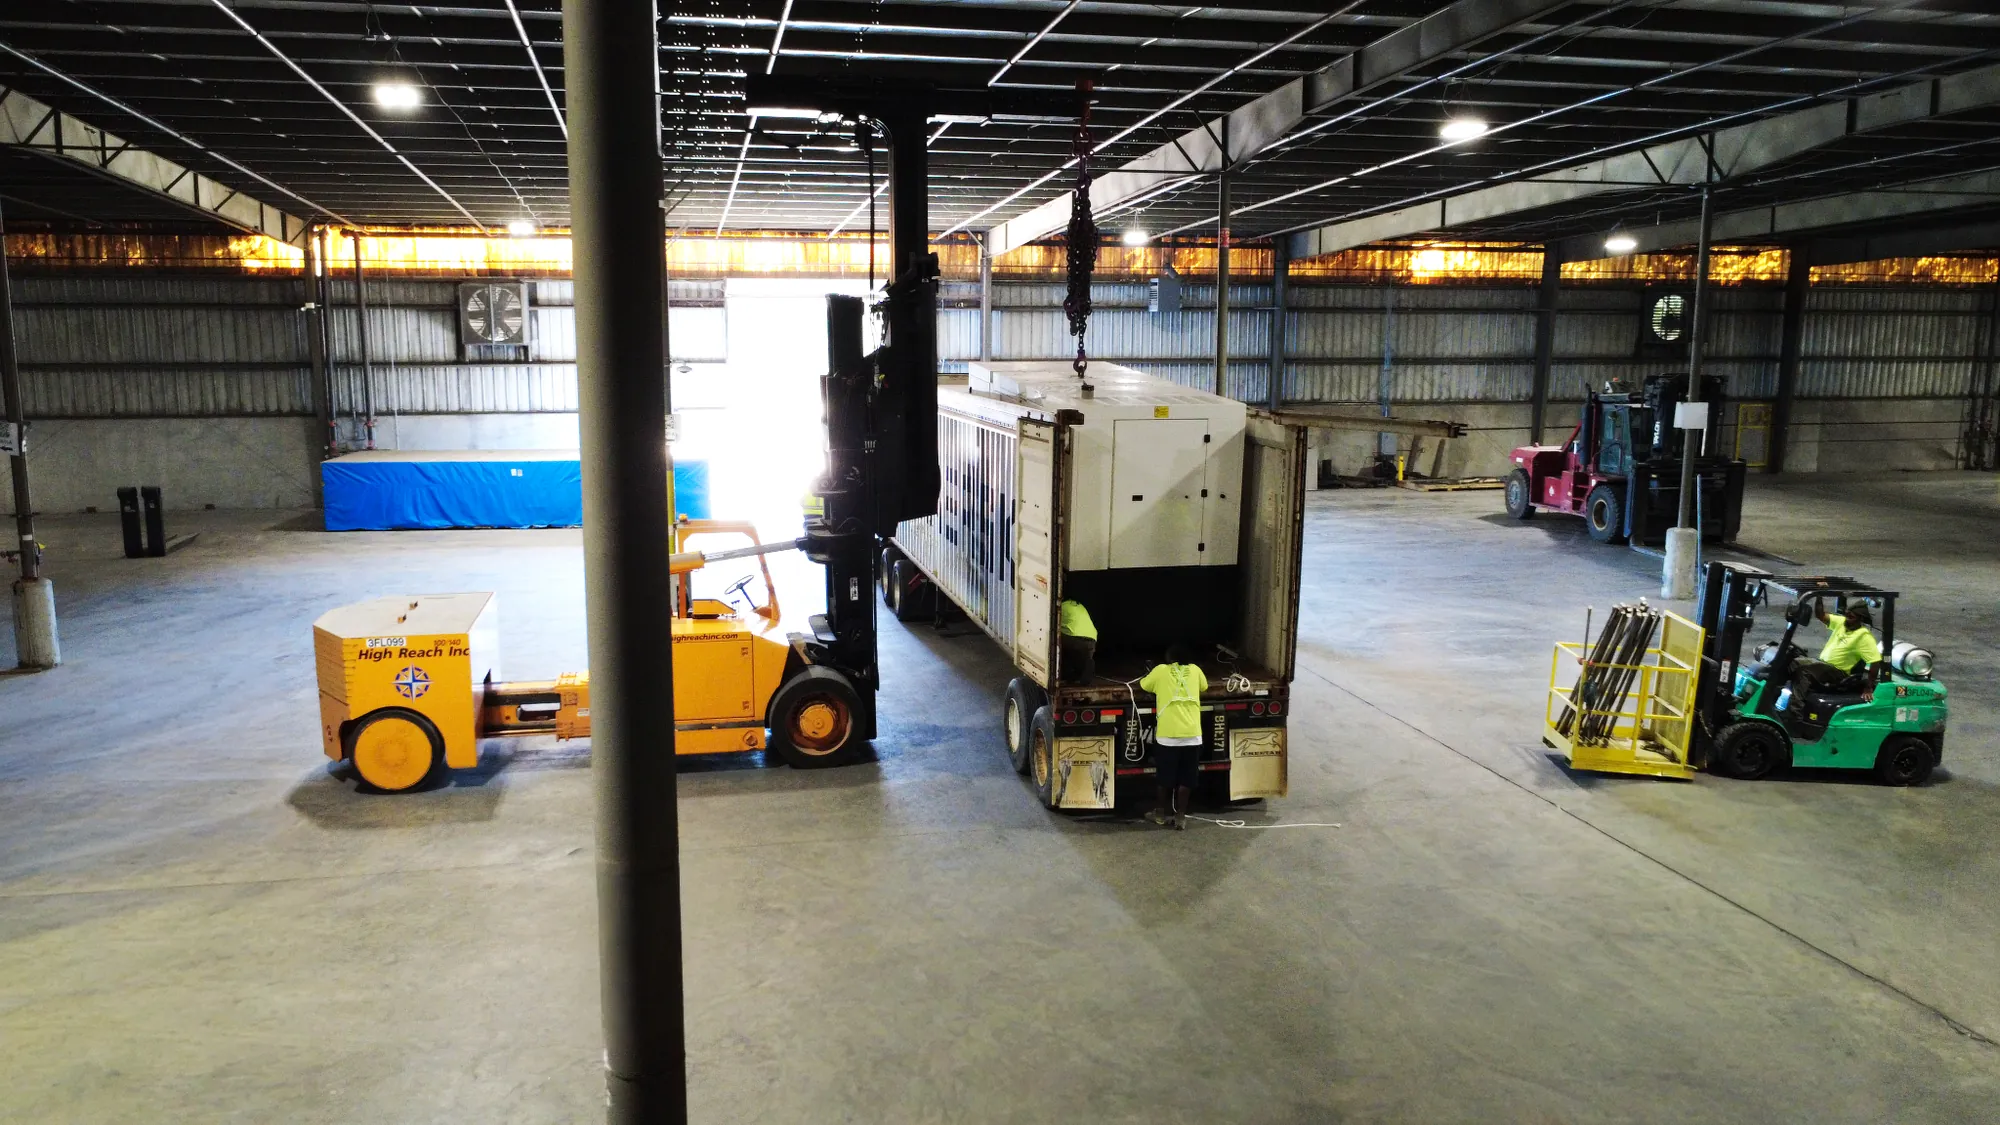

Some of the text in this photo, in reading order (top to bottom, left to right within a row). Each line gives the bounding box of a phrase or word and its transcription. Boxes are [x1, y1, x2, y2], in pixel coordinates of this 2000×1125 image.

[368, 638, 404, 647] 3FL099
[358, 646, 470, 662] High Reach Inc
